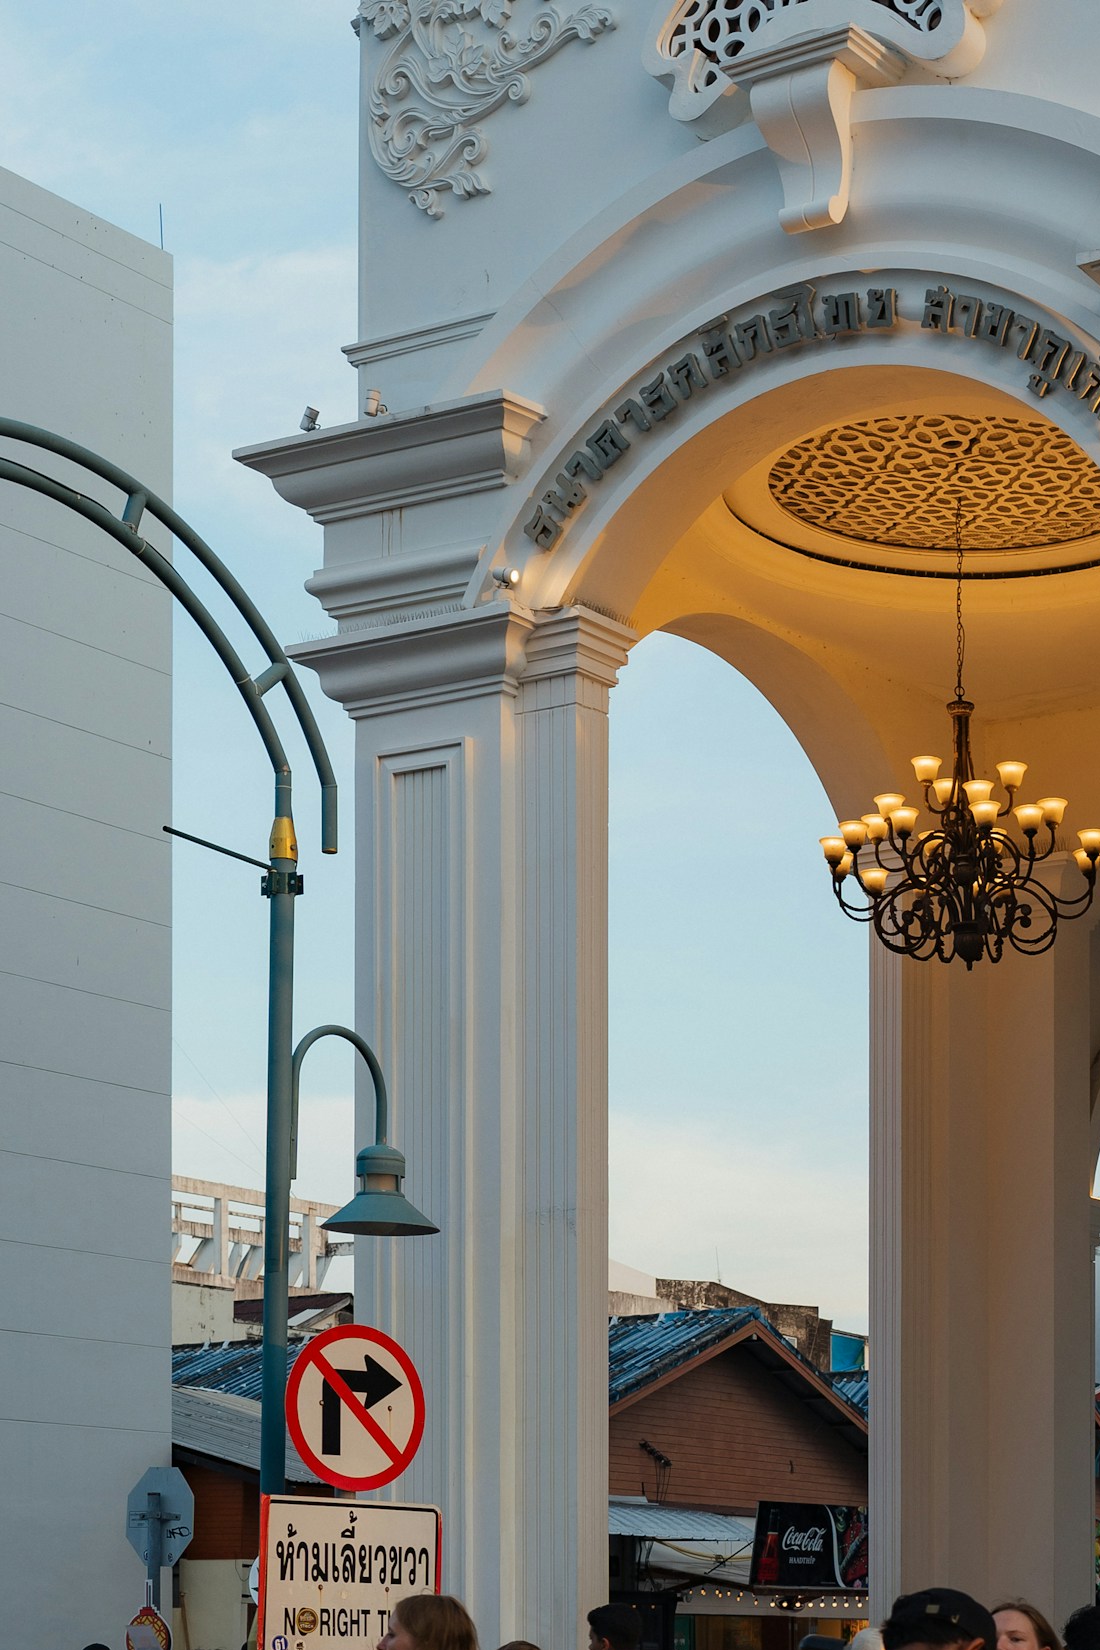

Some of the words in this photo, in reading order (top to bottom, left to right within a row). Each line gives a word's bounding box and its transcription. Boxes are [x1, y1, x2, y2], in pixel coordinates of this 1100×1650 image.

[276, 1510, 430, 1586] ห้ามเลี้ยวขวา
[320, 1608, 371, 1637] RIGHT
